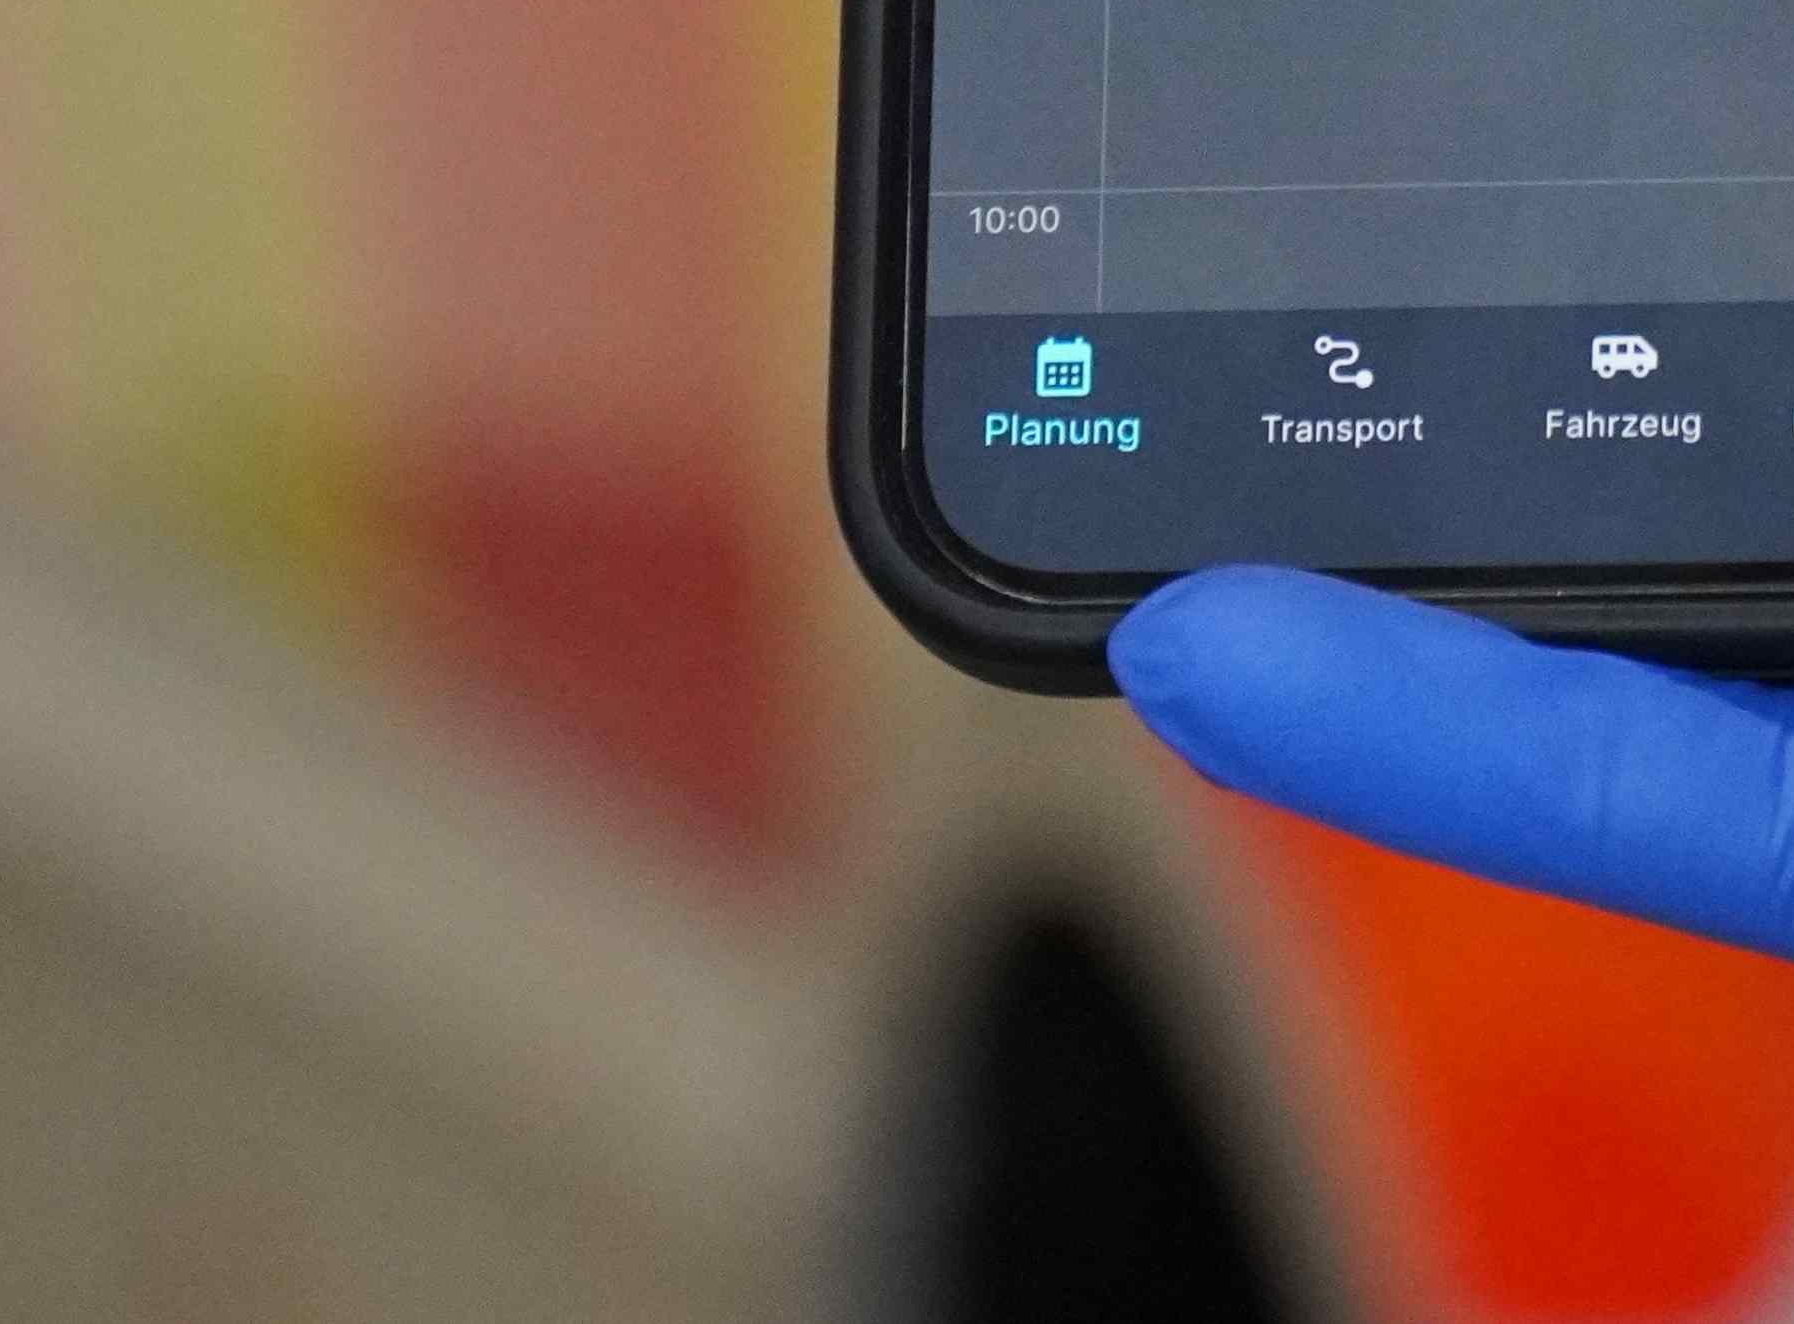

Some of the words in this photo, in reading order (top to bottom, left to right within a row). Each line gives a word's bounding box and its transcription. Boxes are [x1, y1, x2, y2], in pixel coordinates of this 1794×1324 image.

[969, 205, 1061, 235] 10:00
[985, 412, 1140, 452] Planung
[1261, 414, 1424, 448] Transport
[1545, 409, 1702, 444] Fahrzeug
